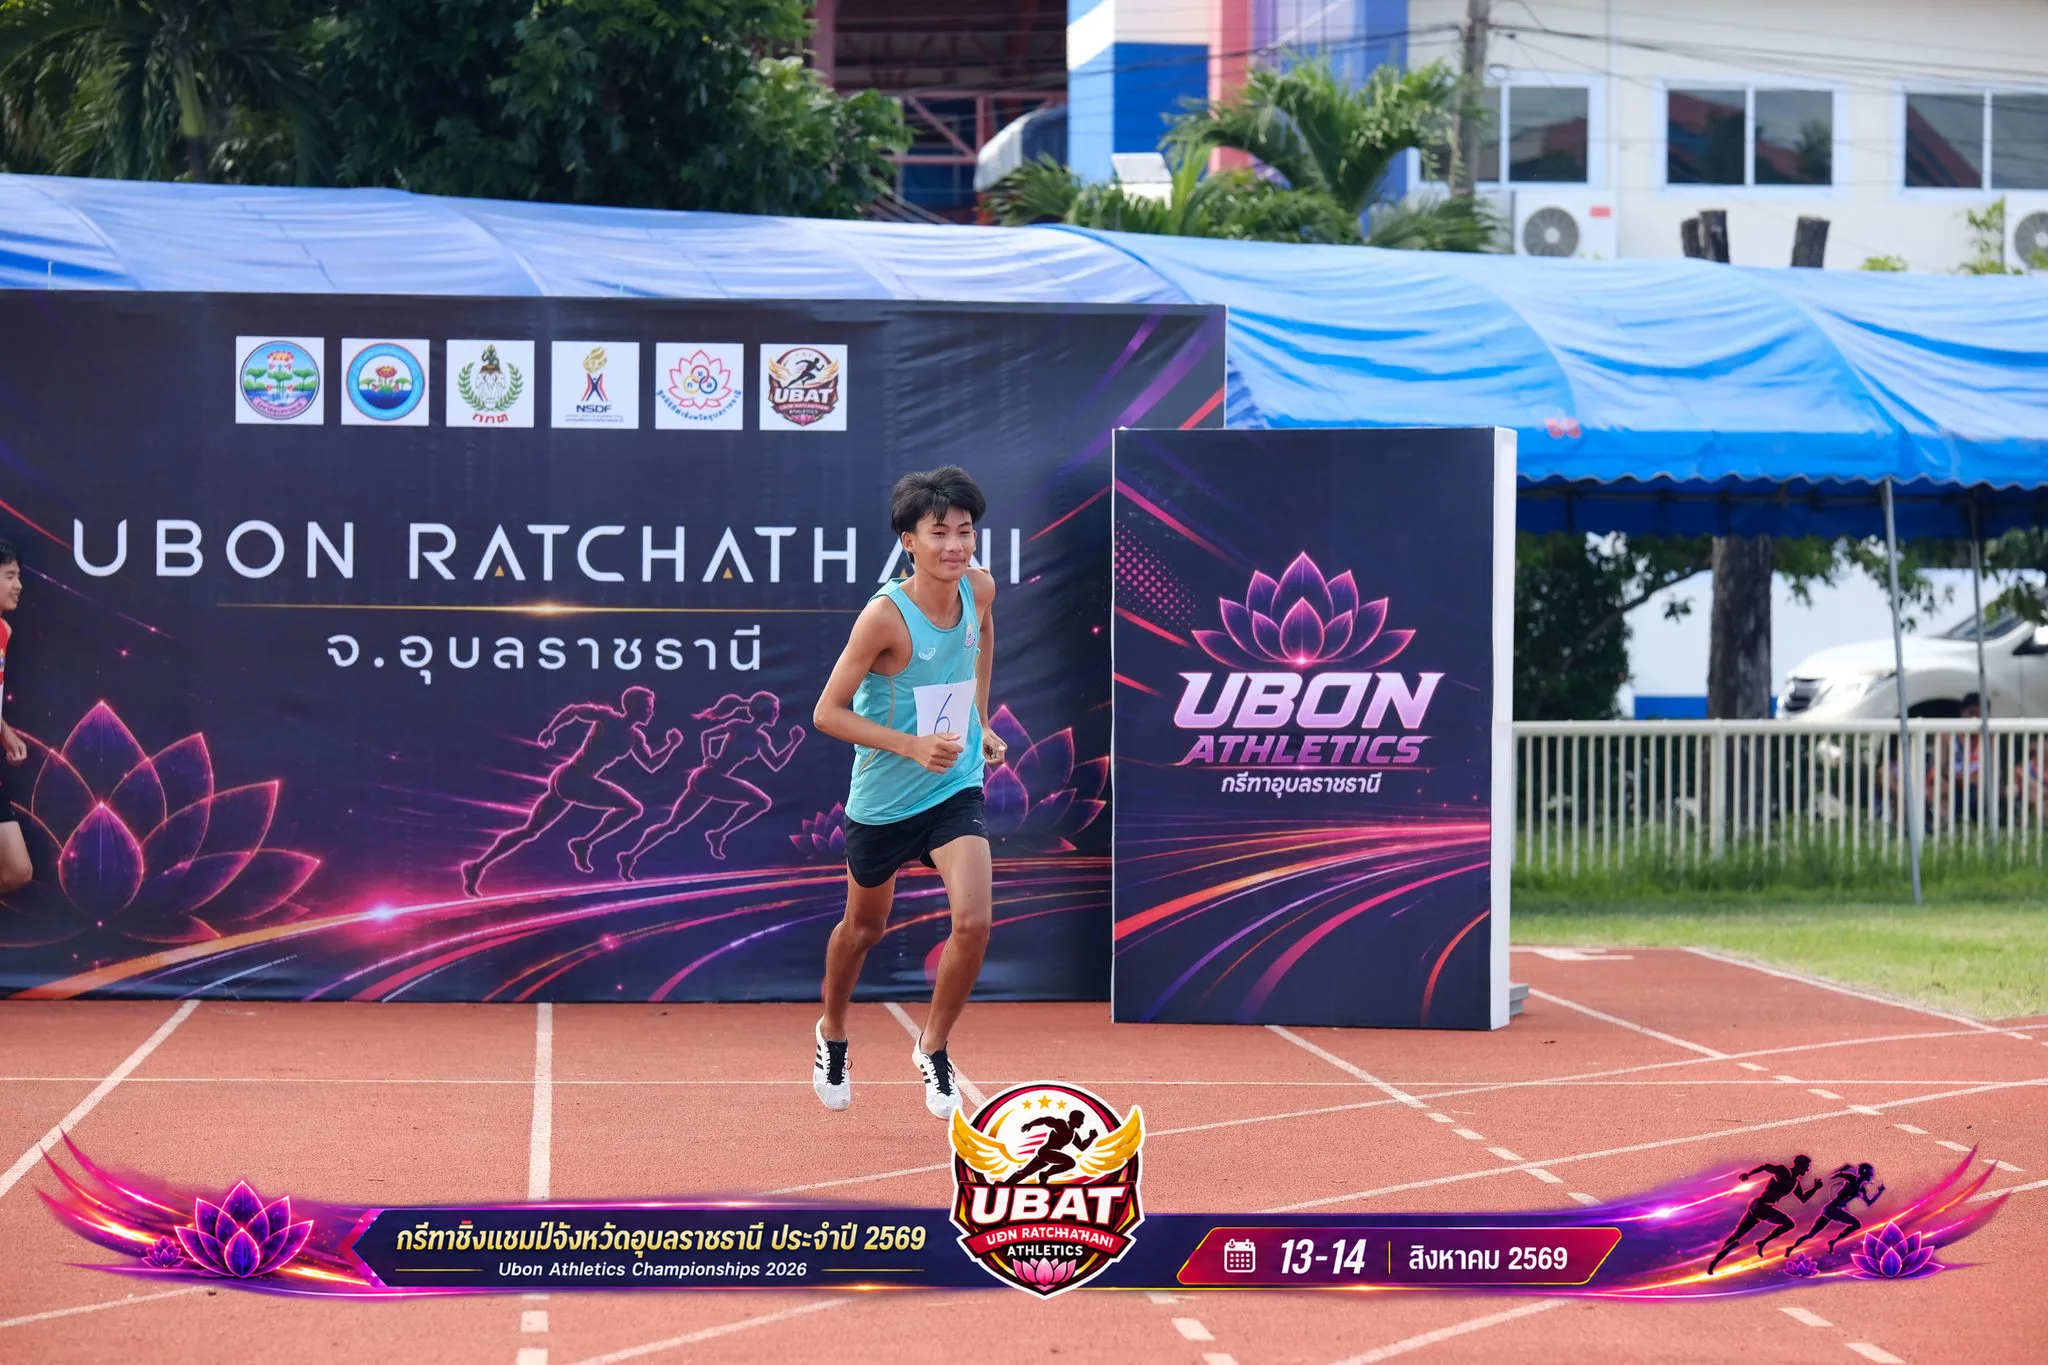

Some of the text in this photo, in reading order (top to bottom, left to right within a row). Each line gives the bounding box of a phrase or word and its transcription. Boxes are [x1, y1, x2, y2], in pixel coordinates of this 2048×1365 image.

[576, 404, 612, 413] NSDF
[774, 388, 834, 404] UBAT
[472, 412, 509, 424] กกท
[73, 519, 354, 579] UBON
[327, 625, 761, 684] จ.อุบลราชธานี
[934, 693, 953, 734] 6
[1173, 672, 1446, 729] UBON
[1184, 734, 1430, 765] ATHLETICS
